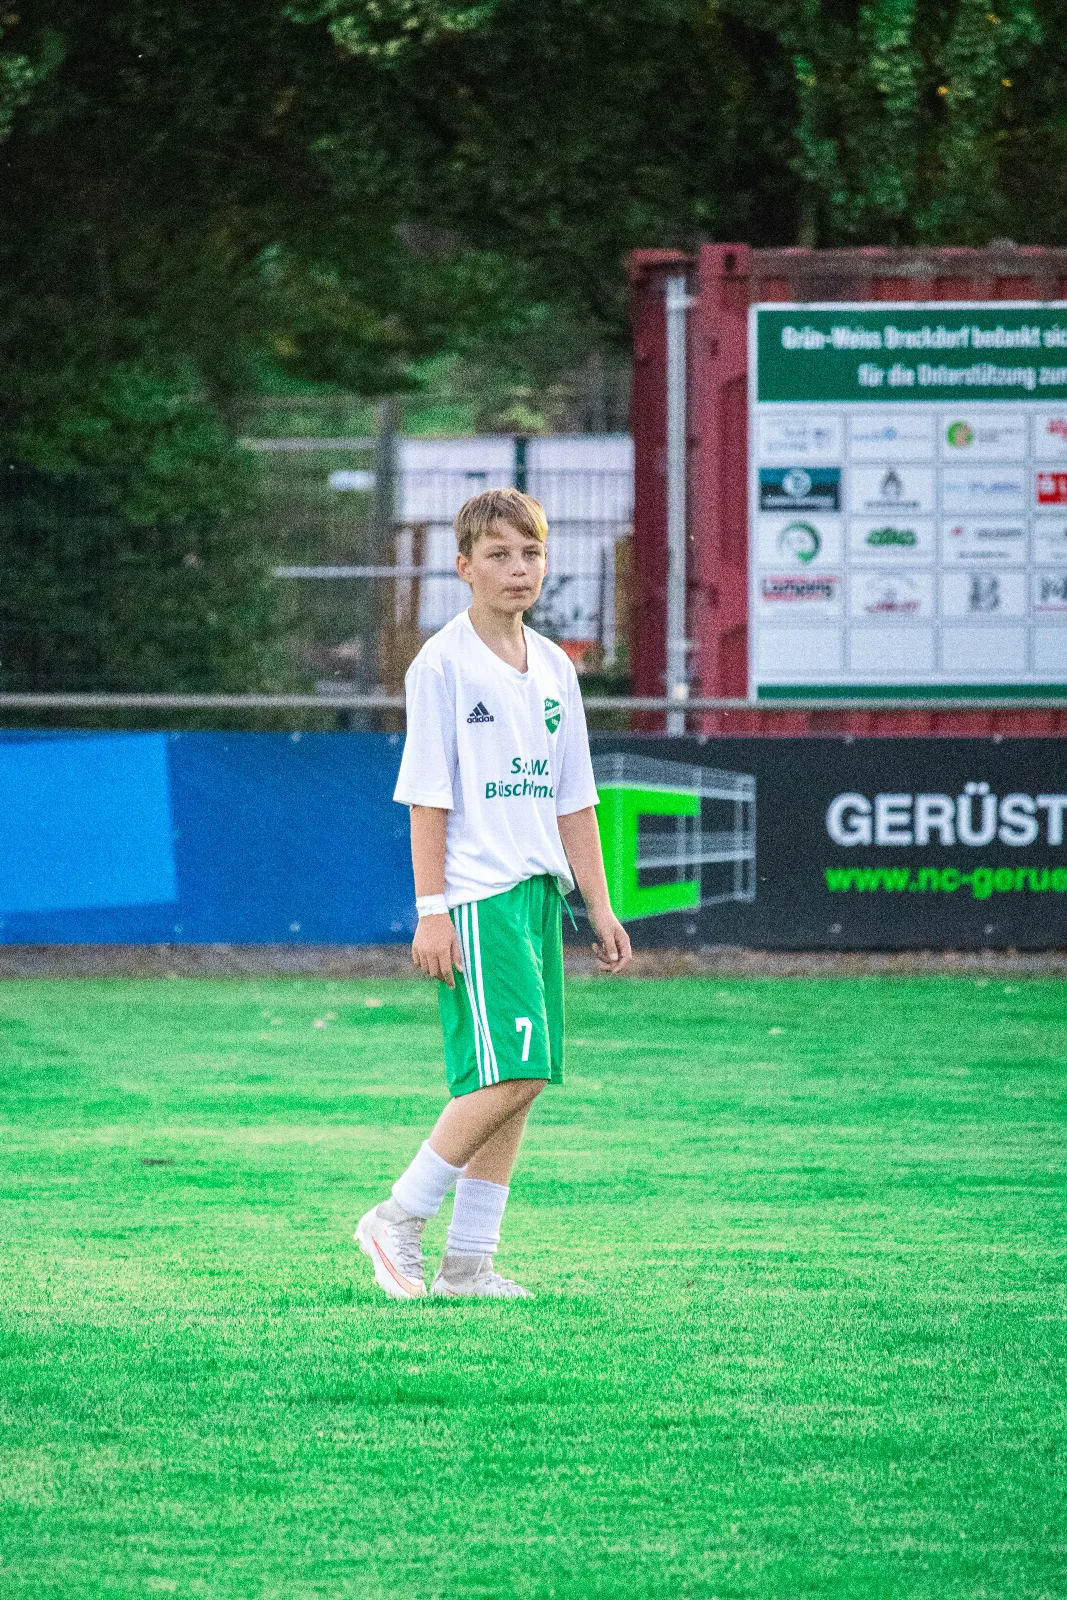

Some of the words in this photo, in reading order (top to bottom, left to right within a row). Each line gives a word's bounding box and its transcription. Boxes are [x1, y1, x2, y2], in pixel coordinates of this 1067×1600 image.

[971, 325, 1040, 349] bedankt
[858, 363, 884, 386] für
[887, 362, 914, 386] die
[916, 362, 1036, 390] Unterstützung
[467, 715, 495, 724] adidas
[826, 781, 1067, 846] GERÜST
[515, 1016, 533, 1062] 7
